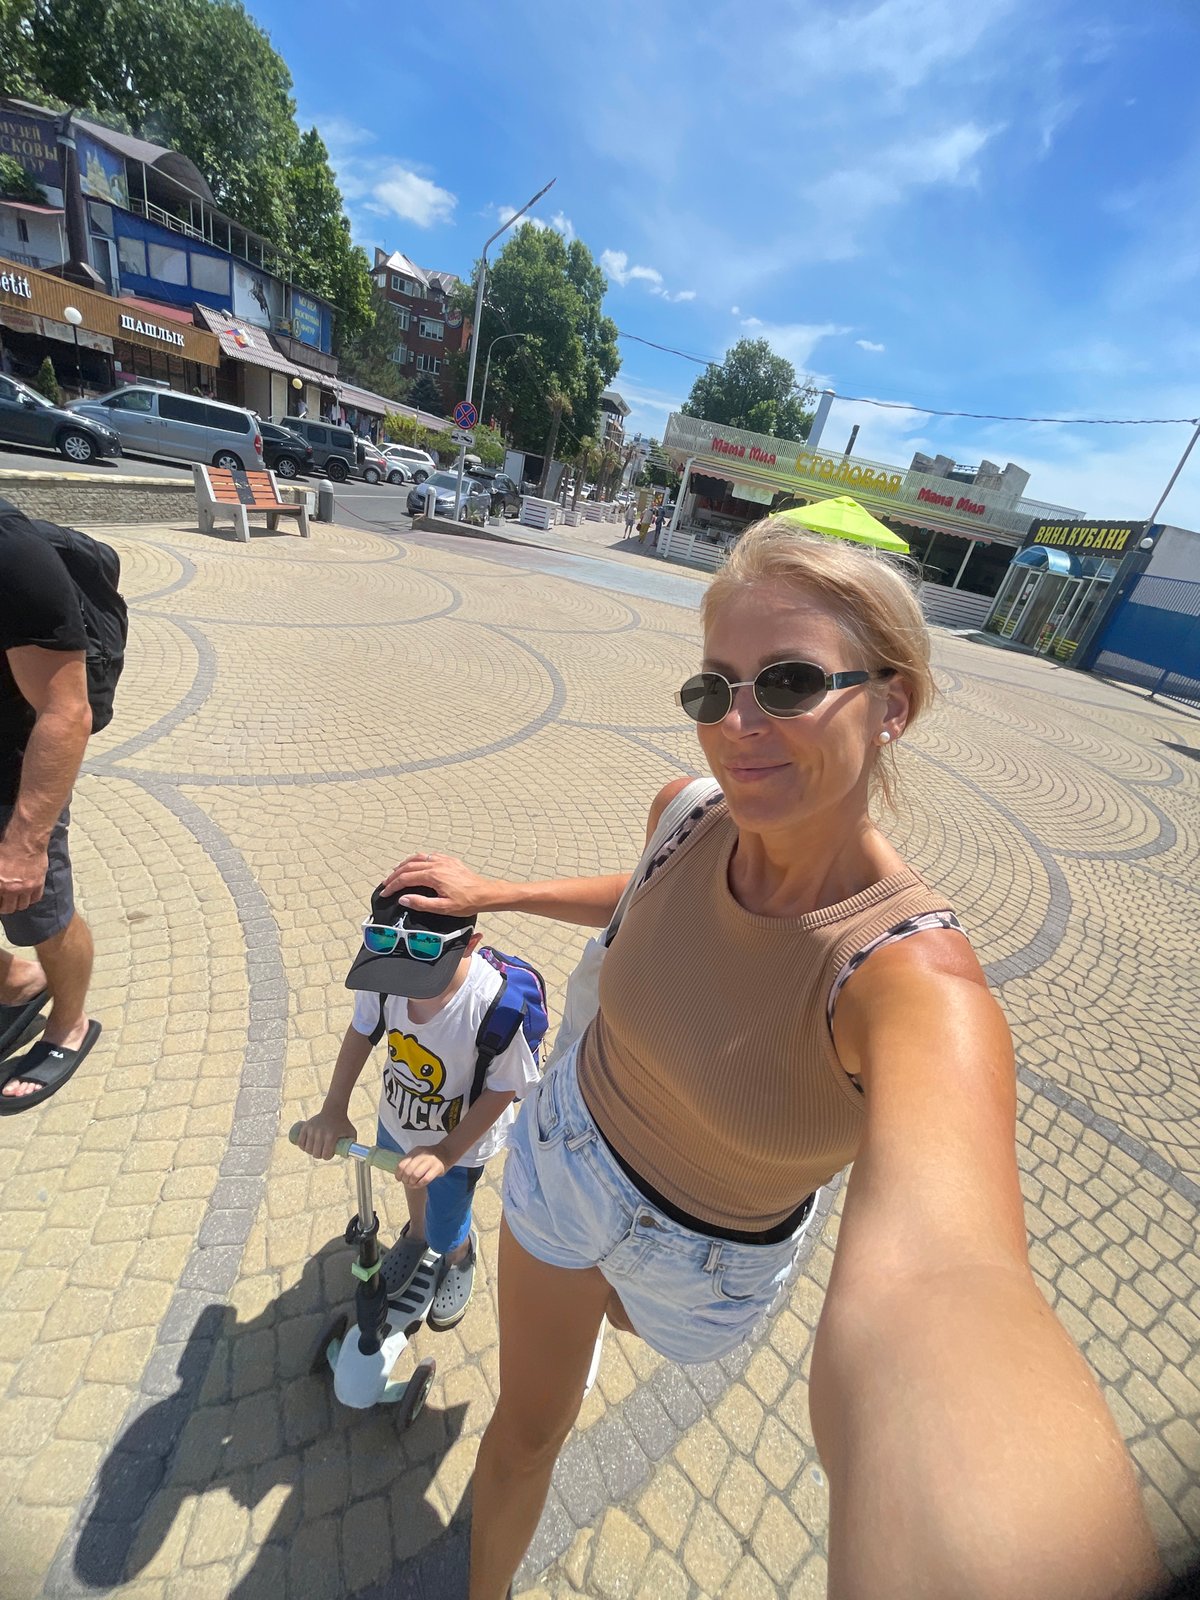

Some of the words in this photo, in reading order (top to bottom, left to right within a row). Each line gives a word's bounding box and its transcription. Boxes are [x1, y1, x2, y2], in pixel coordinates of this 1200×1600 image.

[0, 134, 59, 161] СКОВЫ
[0, 271, 32, 299] étit
[120, 314, 186, 347] ШАШЛЫК
[749, 446, 777, 465] Мия
[795, 452, 902, 494] СТОЛОВАЯ
[1033, 525, 1070, 545] ВИНА
[1068, 527, 1132, 550] КУБАНИ
